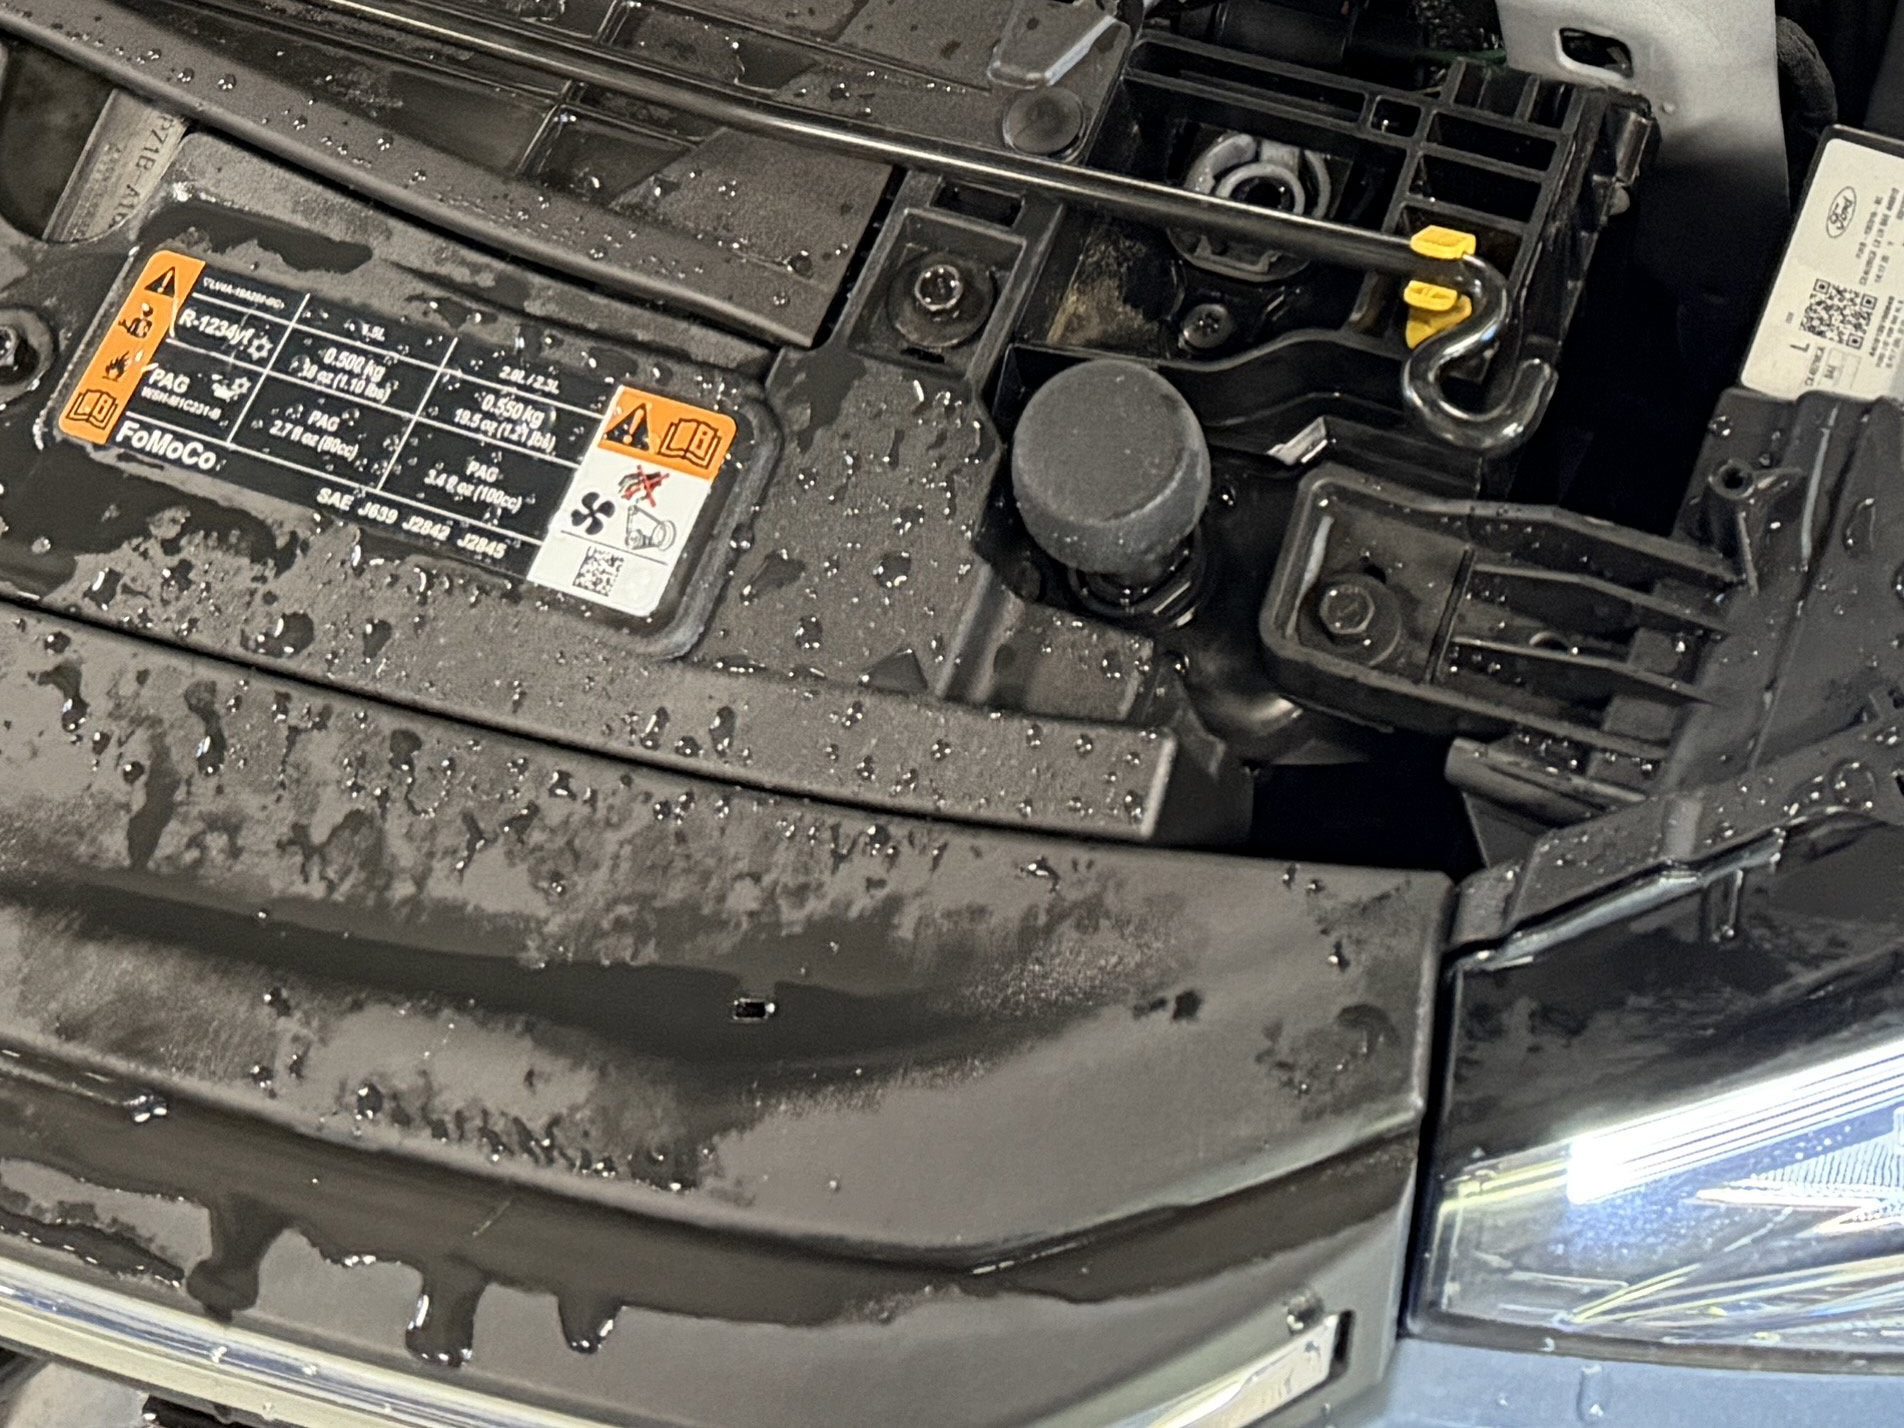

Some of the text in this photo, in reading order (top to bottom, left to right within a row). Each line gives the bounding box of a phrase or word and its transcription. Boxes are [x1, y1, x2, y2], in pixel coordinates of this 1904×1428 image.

[178, 309, 255, 346] R-1234yf
[148, 368, 191, 394] PAG
[323, 347, 387, 383] 0.500 kg
[307, 409, 341, 432] PAG
[481, 393, 545, 430] 0.550 kg
[115, 420, 218, 472] FoMoCo
[465, 459, 500, 483] PAG
[316, 486, 355, 512] SAE
[357, 501, 399, 525] J639
[456, 532, 508, 560] J2845
